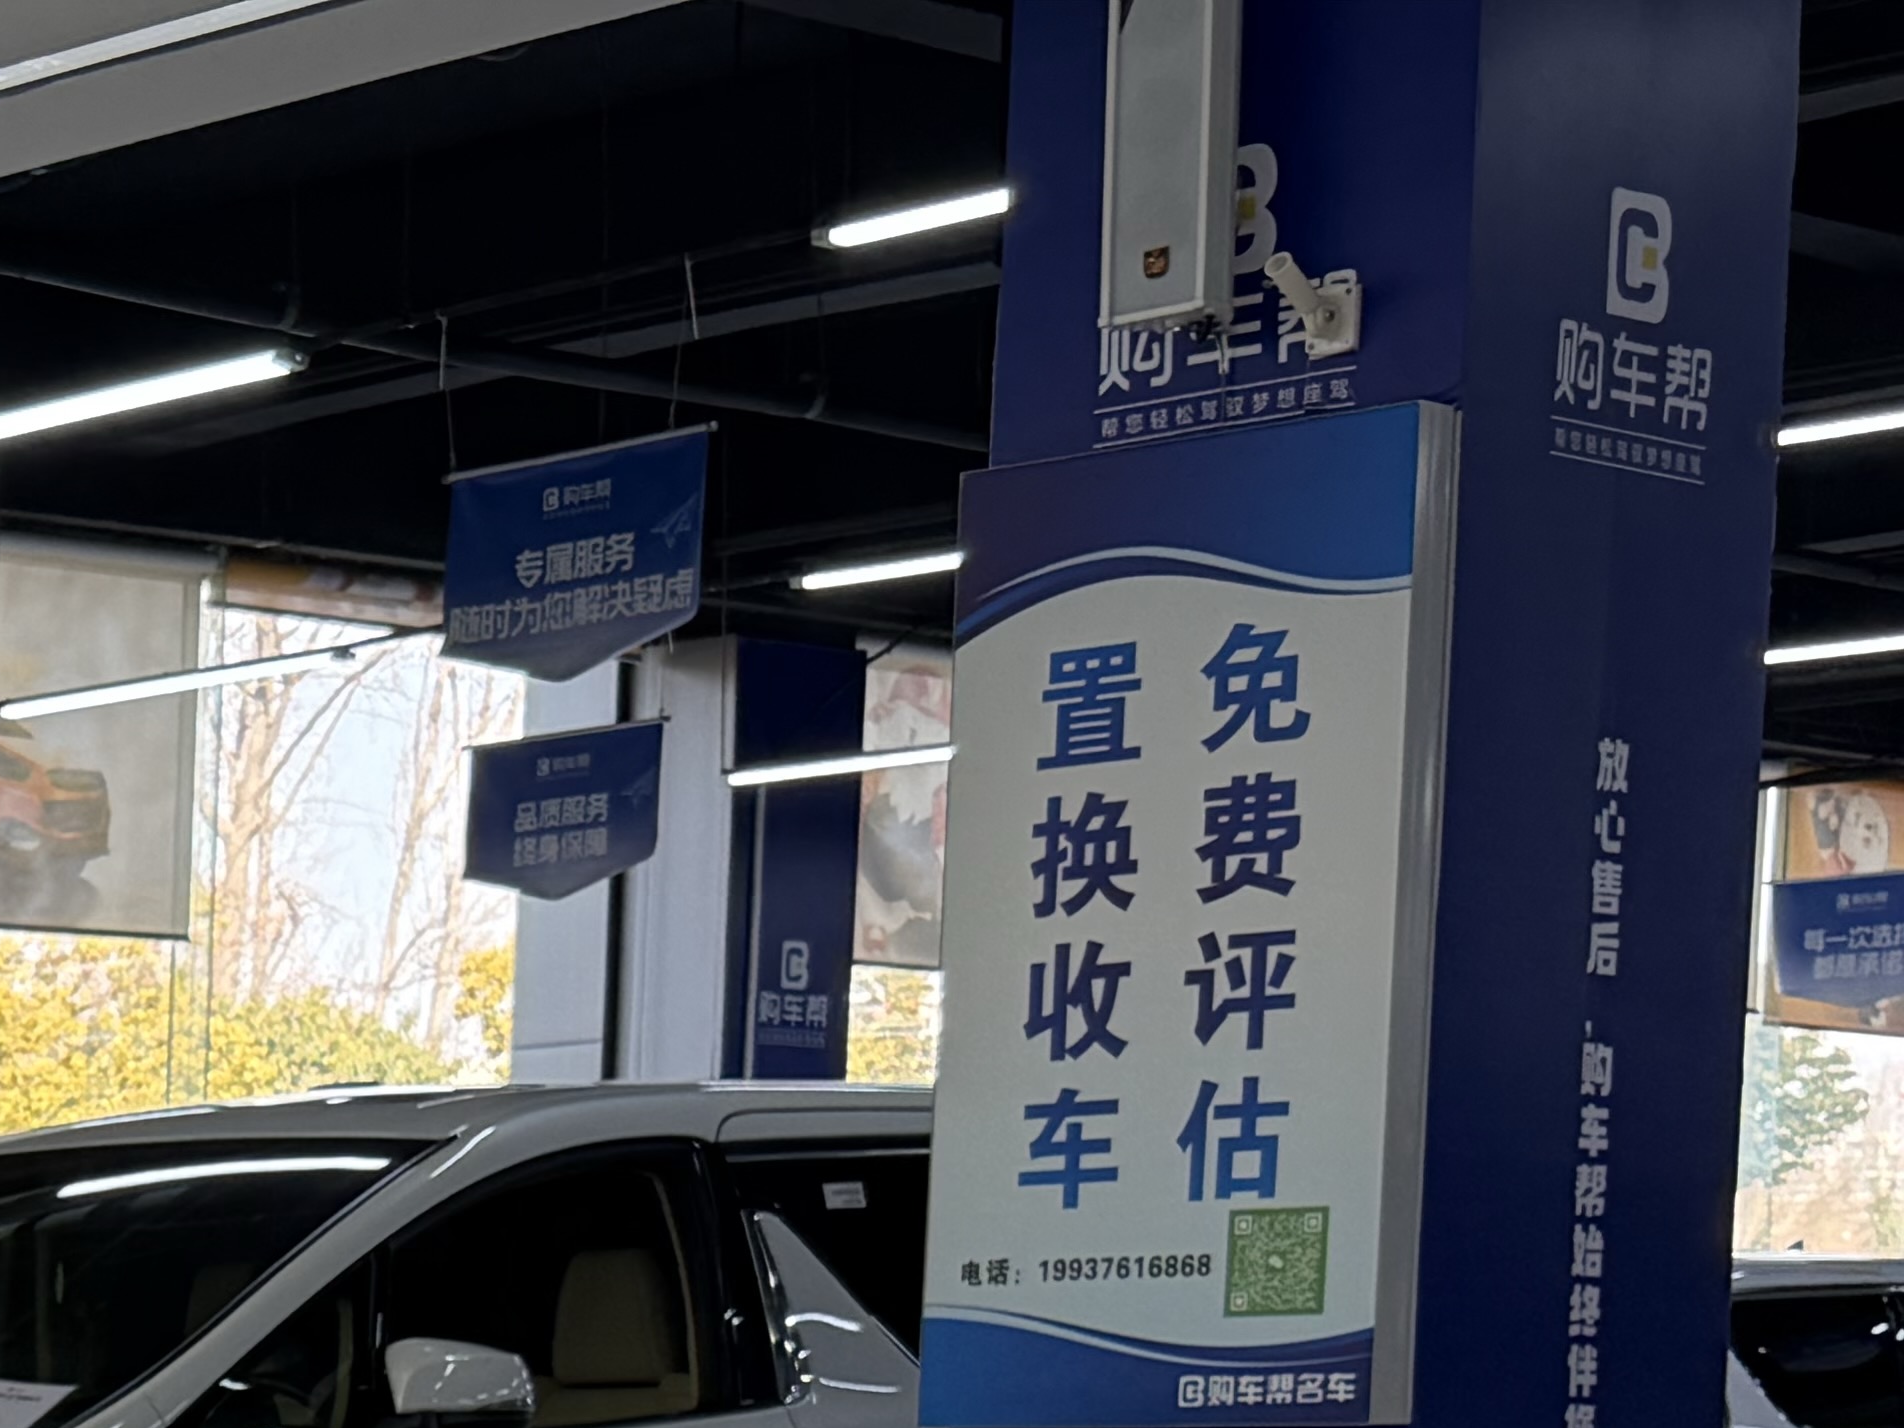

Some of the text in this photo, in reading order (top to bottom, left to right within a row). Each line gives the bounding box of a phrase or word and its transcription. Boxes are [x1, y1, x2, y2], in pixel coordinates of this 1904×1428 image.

[1553, 317, 1713, 431] 购车帮
[1100, 377, 1350, 439] 帮您轻松驾驭梦想座驾
[514, 531, 636, 589] 专属服务
[448, 567, 695, 644] 随时为您解决疑虑
[513, 792, 610, 833] 品质服务
[1018, 640, 1142, 1210] 置换收车
[1176, 622, 1311, 1202] 免费评估
[757, 990, 829, 1029] 购车帮
[1038, 1253, 1214, 1284] 19937616868
[1206, 1371, 1357, 1407] 购车帮名车
